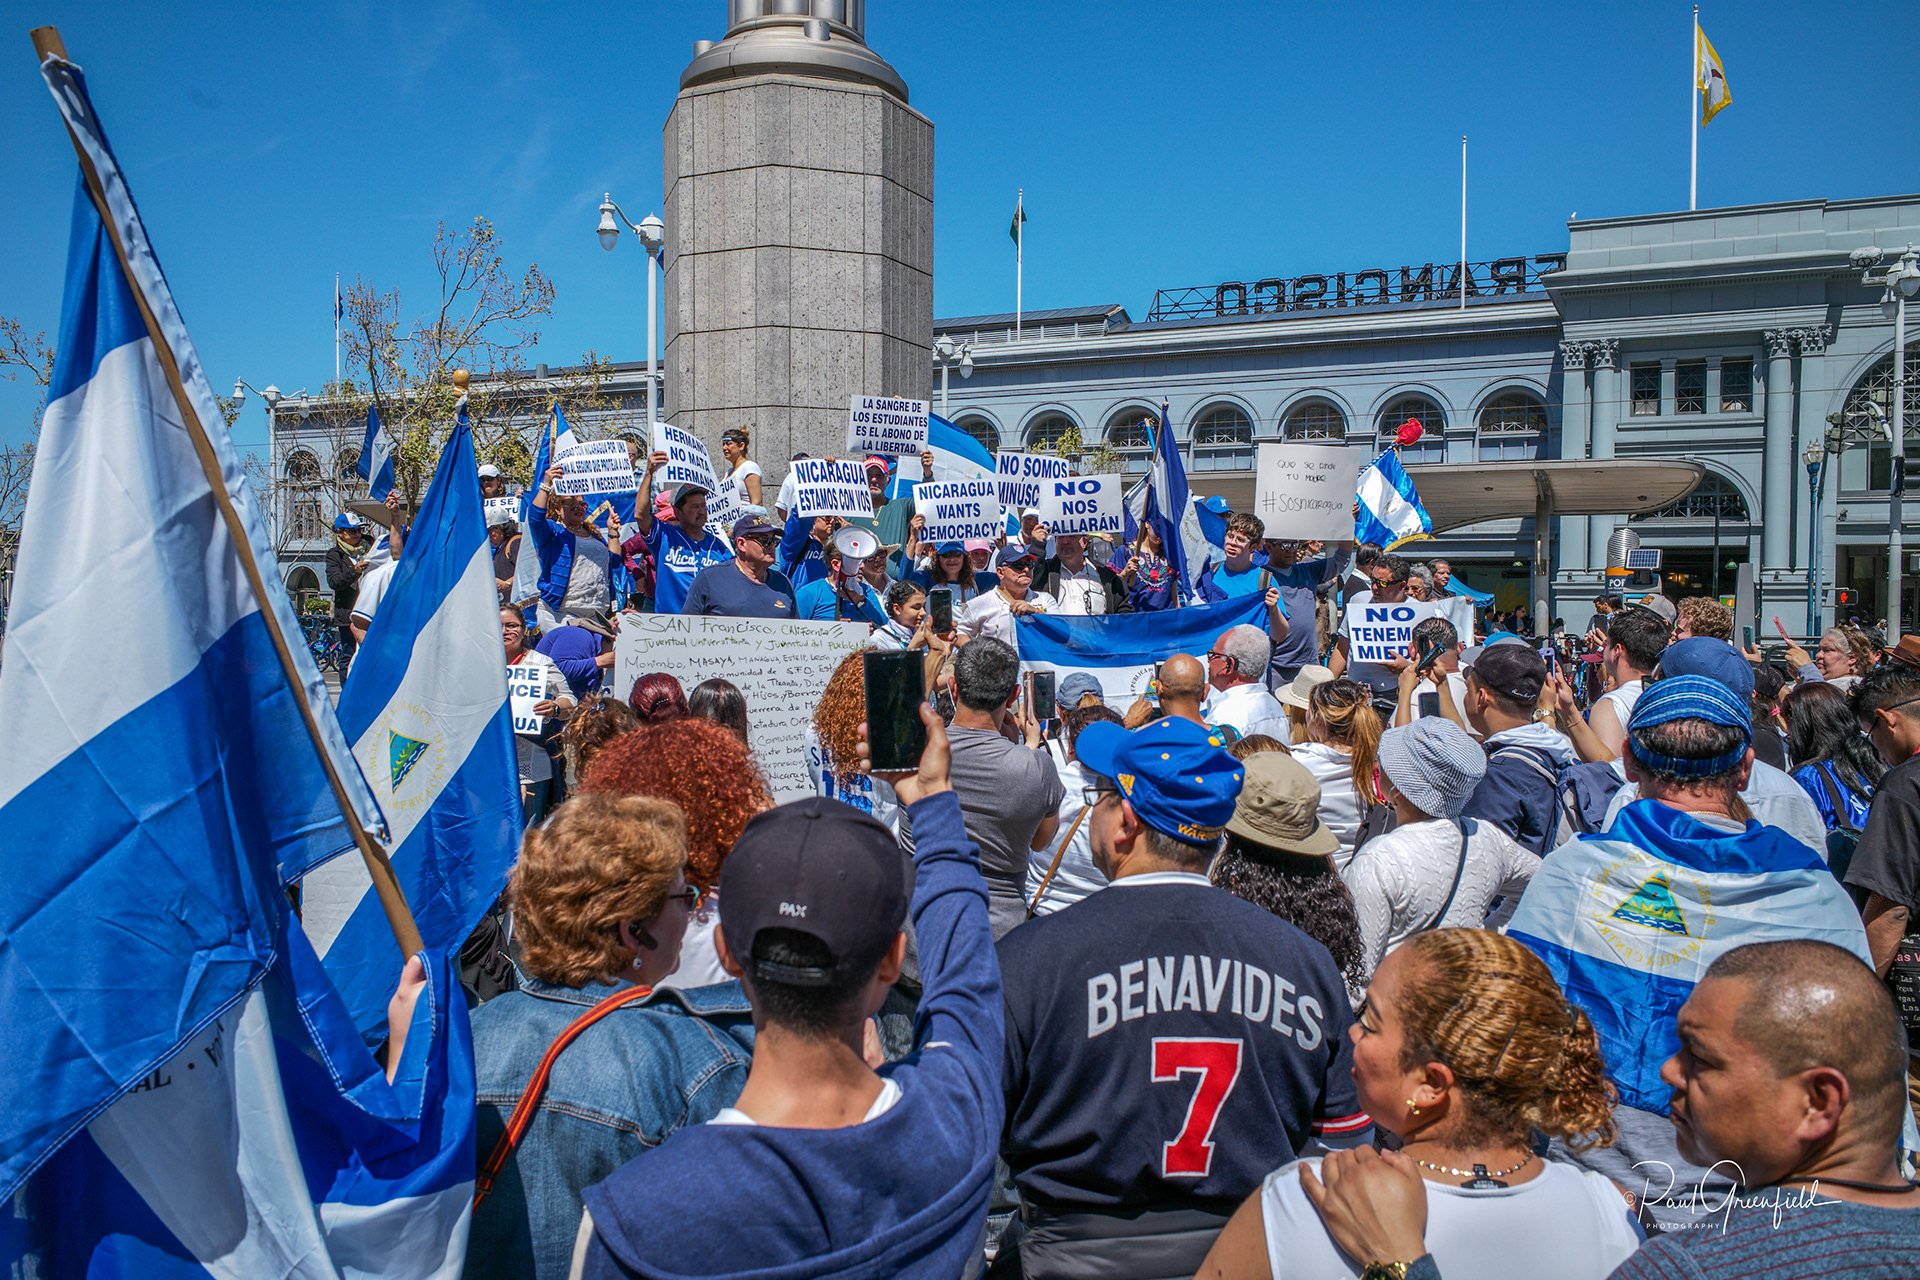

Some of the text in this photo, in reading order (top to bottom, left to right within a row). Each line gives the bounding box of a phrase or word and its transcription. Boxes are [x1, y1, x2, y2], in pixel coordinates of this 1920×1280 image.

[863, 398, 922, 413] LA SANGRE DE
[853, 411, 928, 427] LOS ESTUDIANTES
[664, 426, 708, 457] HERMANO
[856, 426, 924, 441] ES EL ABONO DE
[862, 440, 917, 454] LA LIBERTAD
[669, 446, 711, 473] NO MATA
[1000, 455, 1068, 479] NO SOMOS
[667, 465, 716, 492] HERMANO
[795, 461, 867, 485] NICARAGUA
[918, 481, 995, 500] NICARAGUA
[999, 477, 1040, 507] MINÚSC
[1054, 479, 1101, 497] NO
[500, 498, 514, 506] SE
[798, 488, 871, 512] ESTAMOS CON VOS
[1062, 499, 1098, 515] NOS
[936, 502, 981, 520] WANTS
[921, 522, 998, 541] DEMOCRACY
[1365, 607, 1416, 622] NO
[642, 615, 691, 633] SAN
[1351, 627, 1412, 642] TENEM
[1357, 645, 1411, 660] MIED
[767, 667, 777, 675] de
[741, 682, 752, 691] de
[757, 680, 766, 689] la
[769, 772, 810, 783] Nicaragu
[778, 901, 808, 919] PAX
[1087, 954, 1324, 1051] BENAVIDES
[1151, 1036, 1244, 1179] 7
